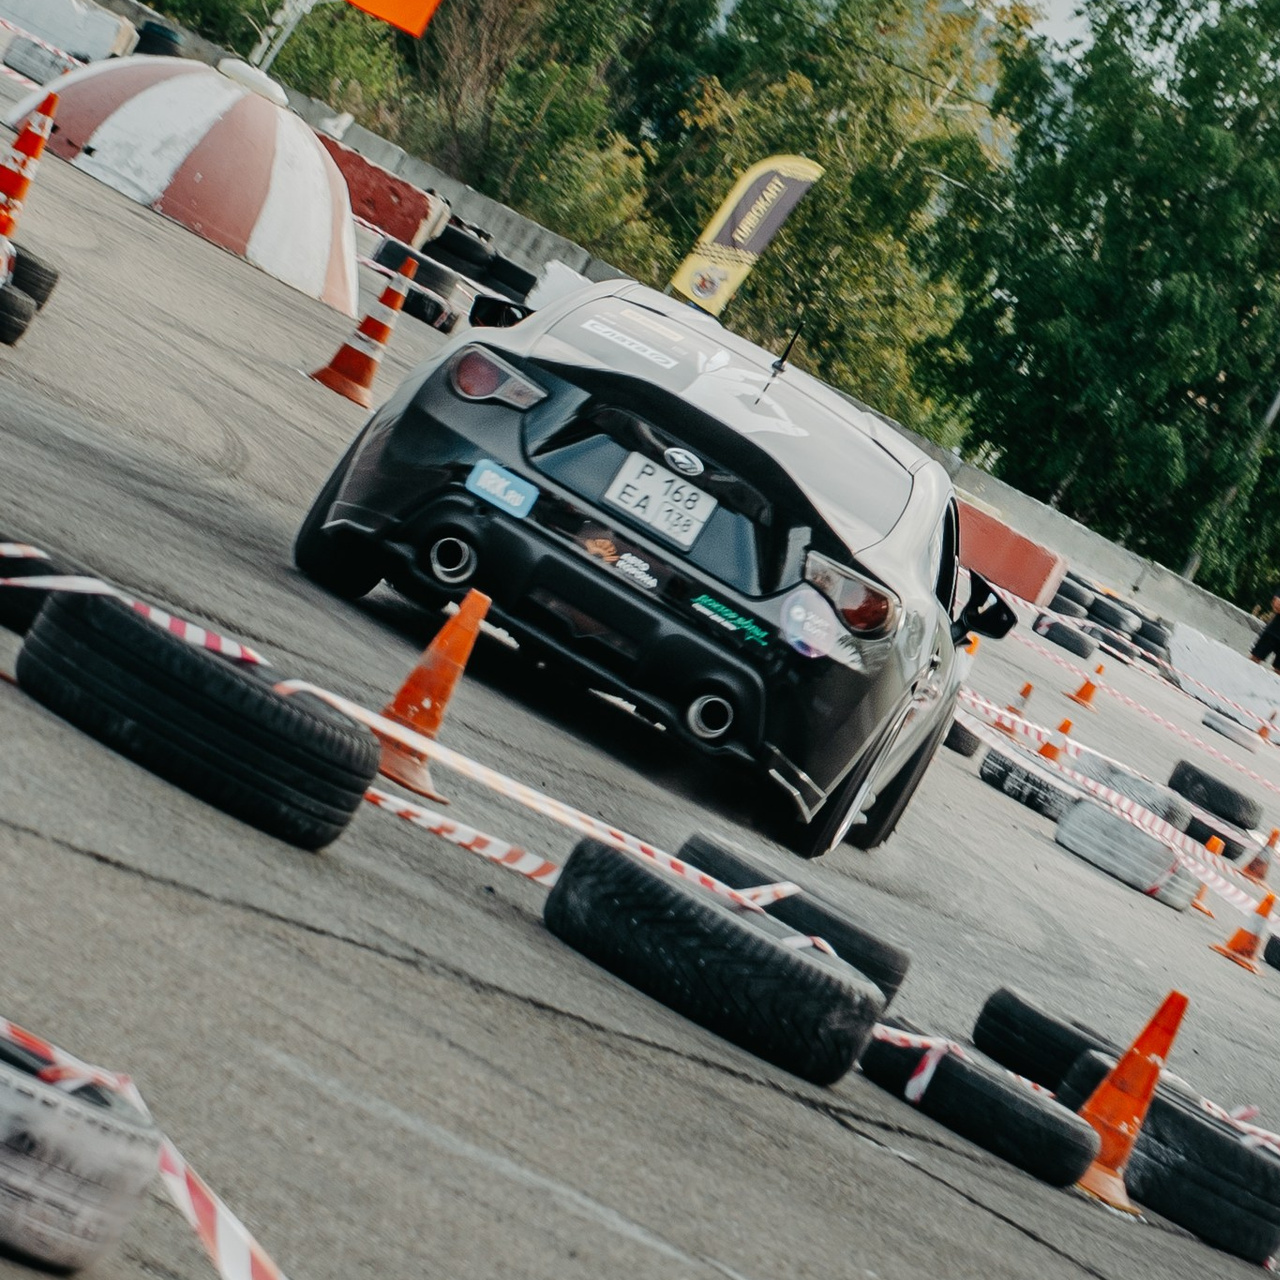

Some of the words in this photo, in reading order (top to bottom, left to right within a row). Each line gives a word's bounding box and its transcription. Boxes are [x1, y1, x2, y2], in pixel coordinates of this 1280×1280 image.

[731, 175, 785, 244] TURBOKART
[662, 479, 700, 510] 168
[664, 508, 695, 533] 138
